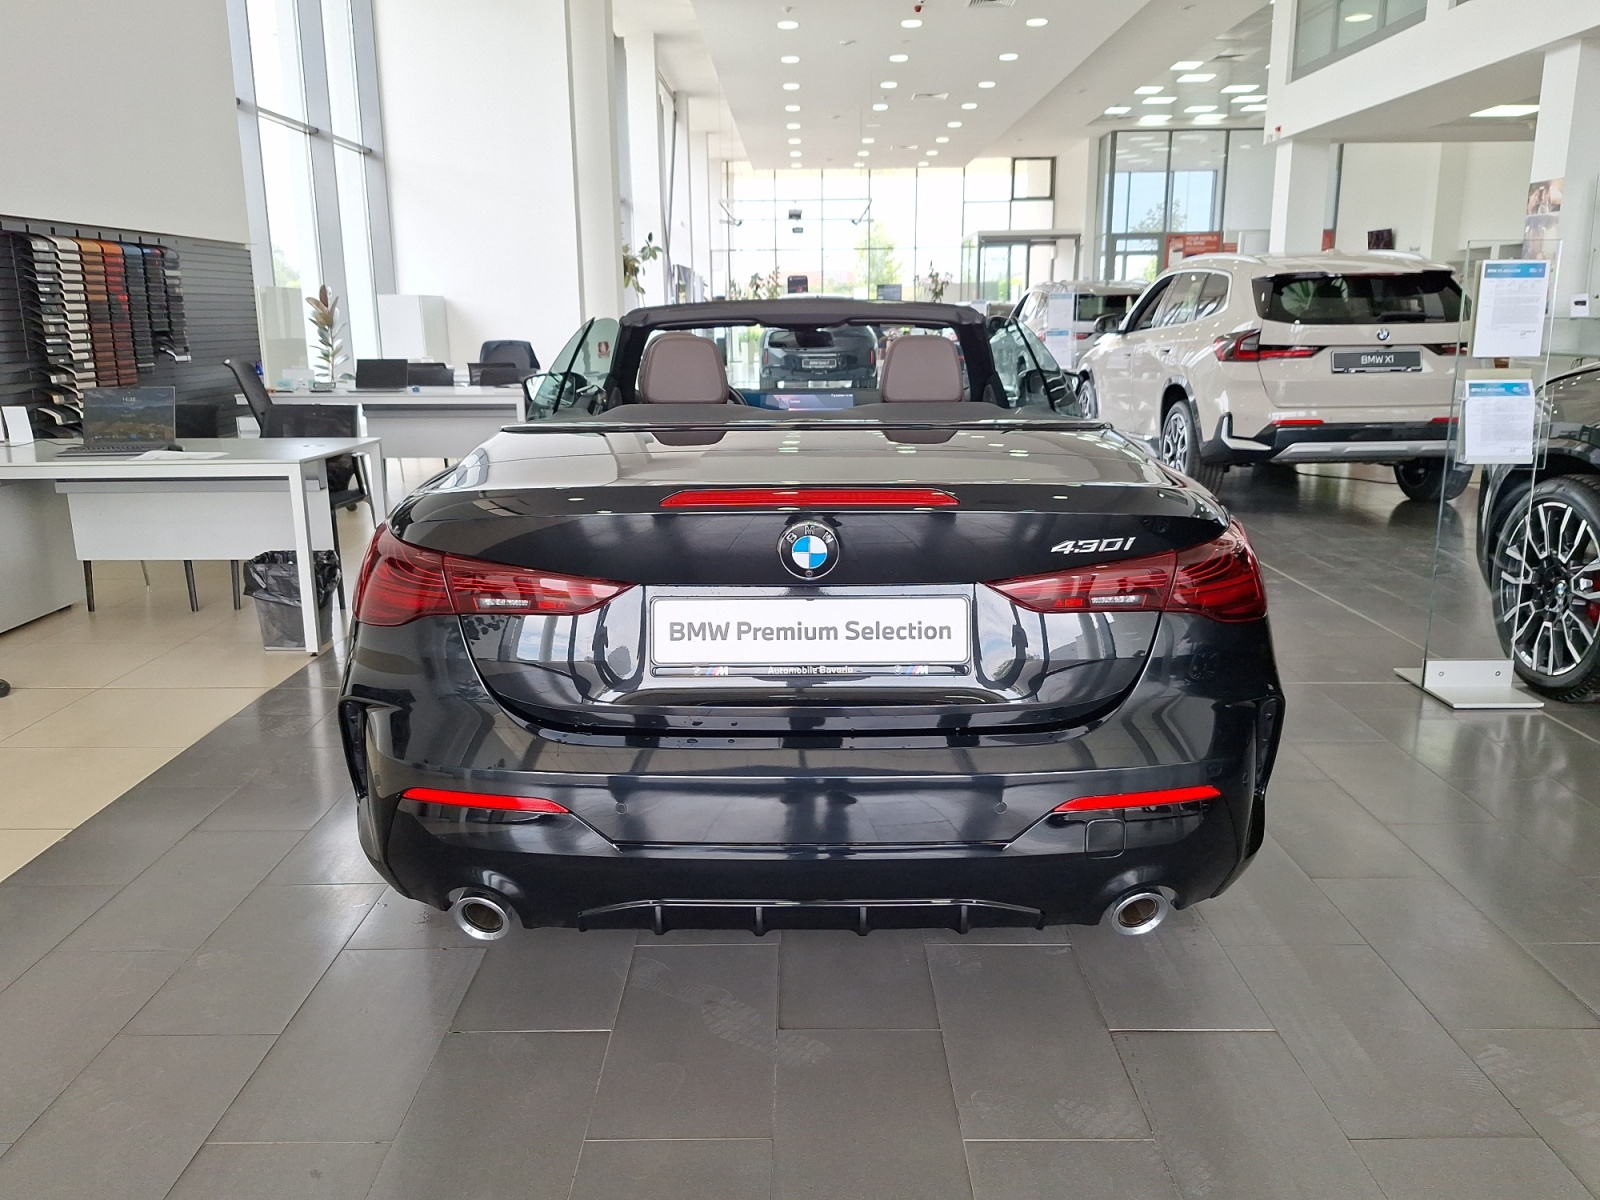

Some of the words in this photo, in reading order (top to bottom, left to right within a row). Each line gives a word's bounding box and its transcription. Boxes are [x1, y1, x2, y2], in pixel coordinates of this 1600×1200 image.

[1360, 355, 1383, 365] BMW
[1384, 354, 1395, 364] X1
[786, 525, 834, 544] BMW
[669, 620, 731, 642] BMW
[737, 619, 839, 642] Premium
[845, 618, 952, 641] Selection
[767, 666, 818, 675] Automobile
[819, 666, 854, 674] Bavaria
